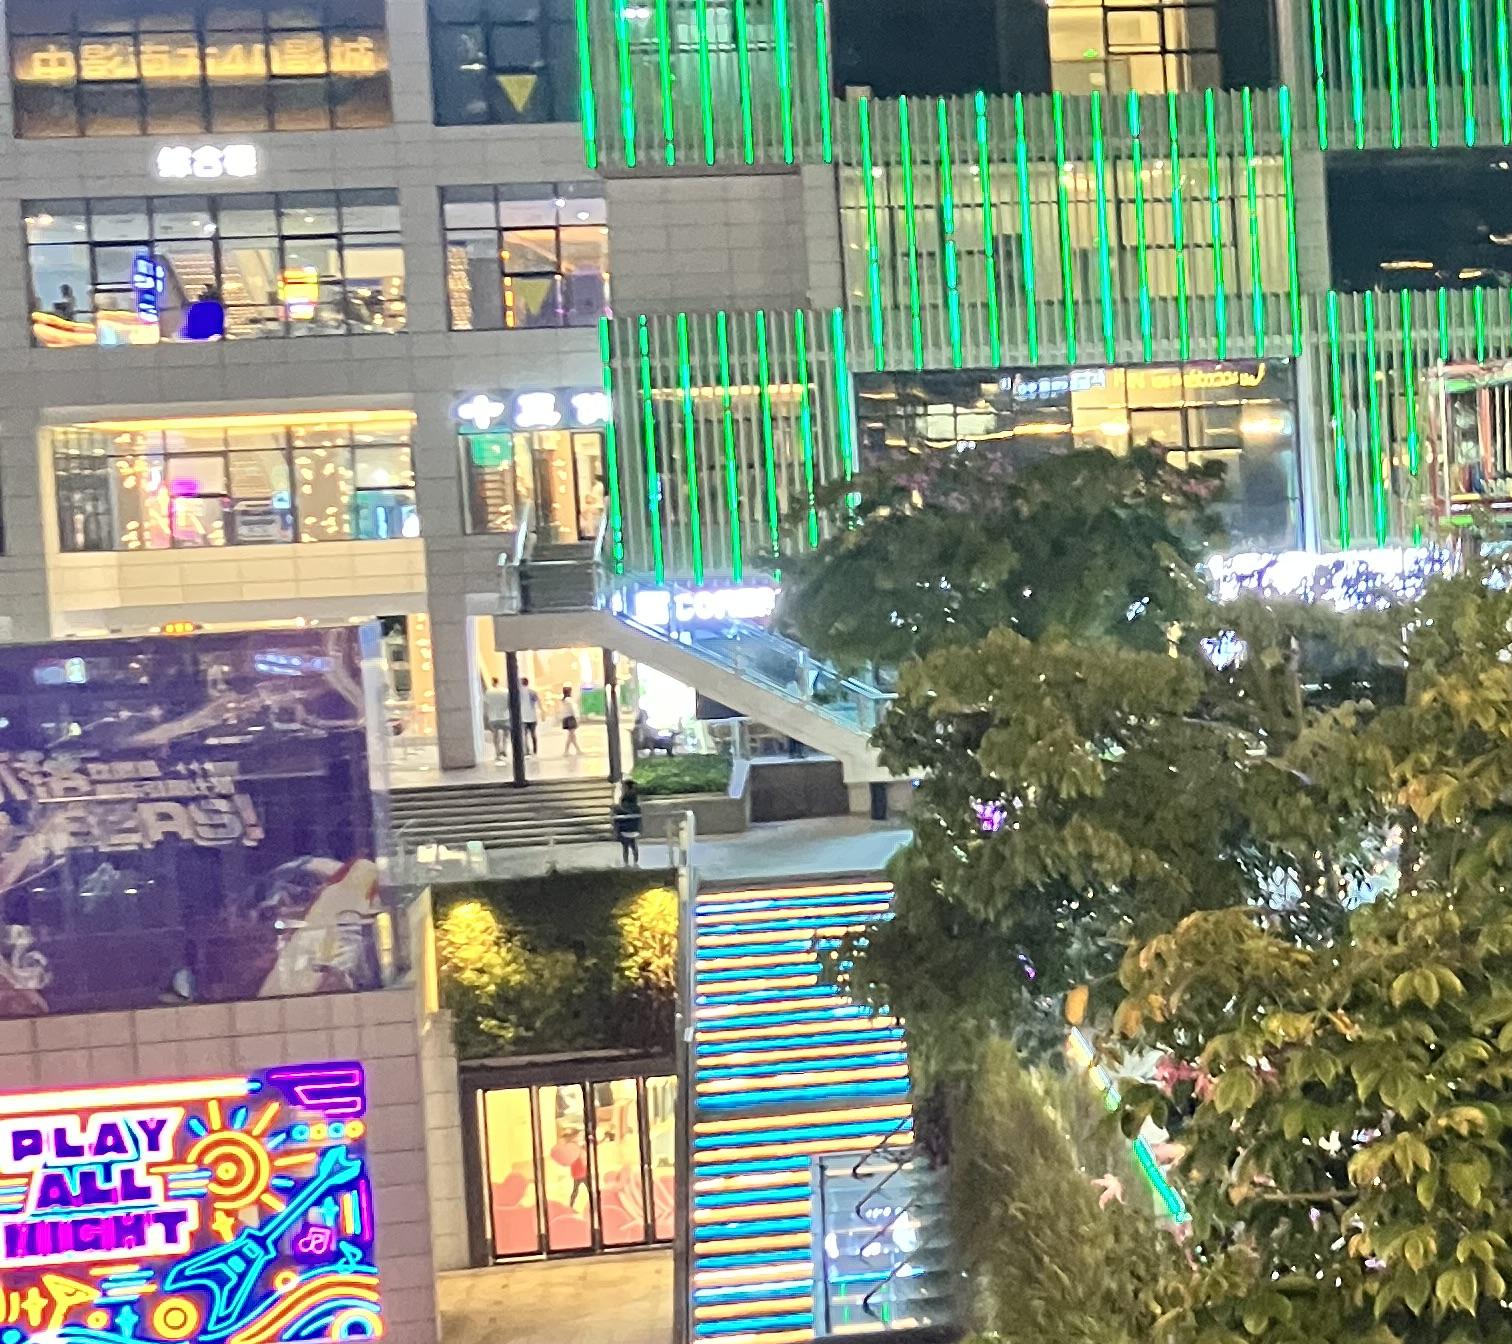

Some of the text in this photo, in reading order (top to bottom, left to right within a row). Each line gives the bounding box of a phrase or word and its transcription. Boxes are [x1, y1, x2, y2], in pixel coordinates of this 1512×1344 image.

[12, 1118, 168, 1161] PLAY
[36, 1168, 153, 1209] ALL
[5, 1210, 188, 1259] NIGHT
